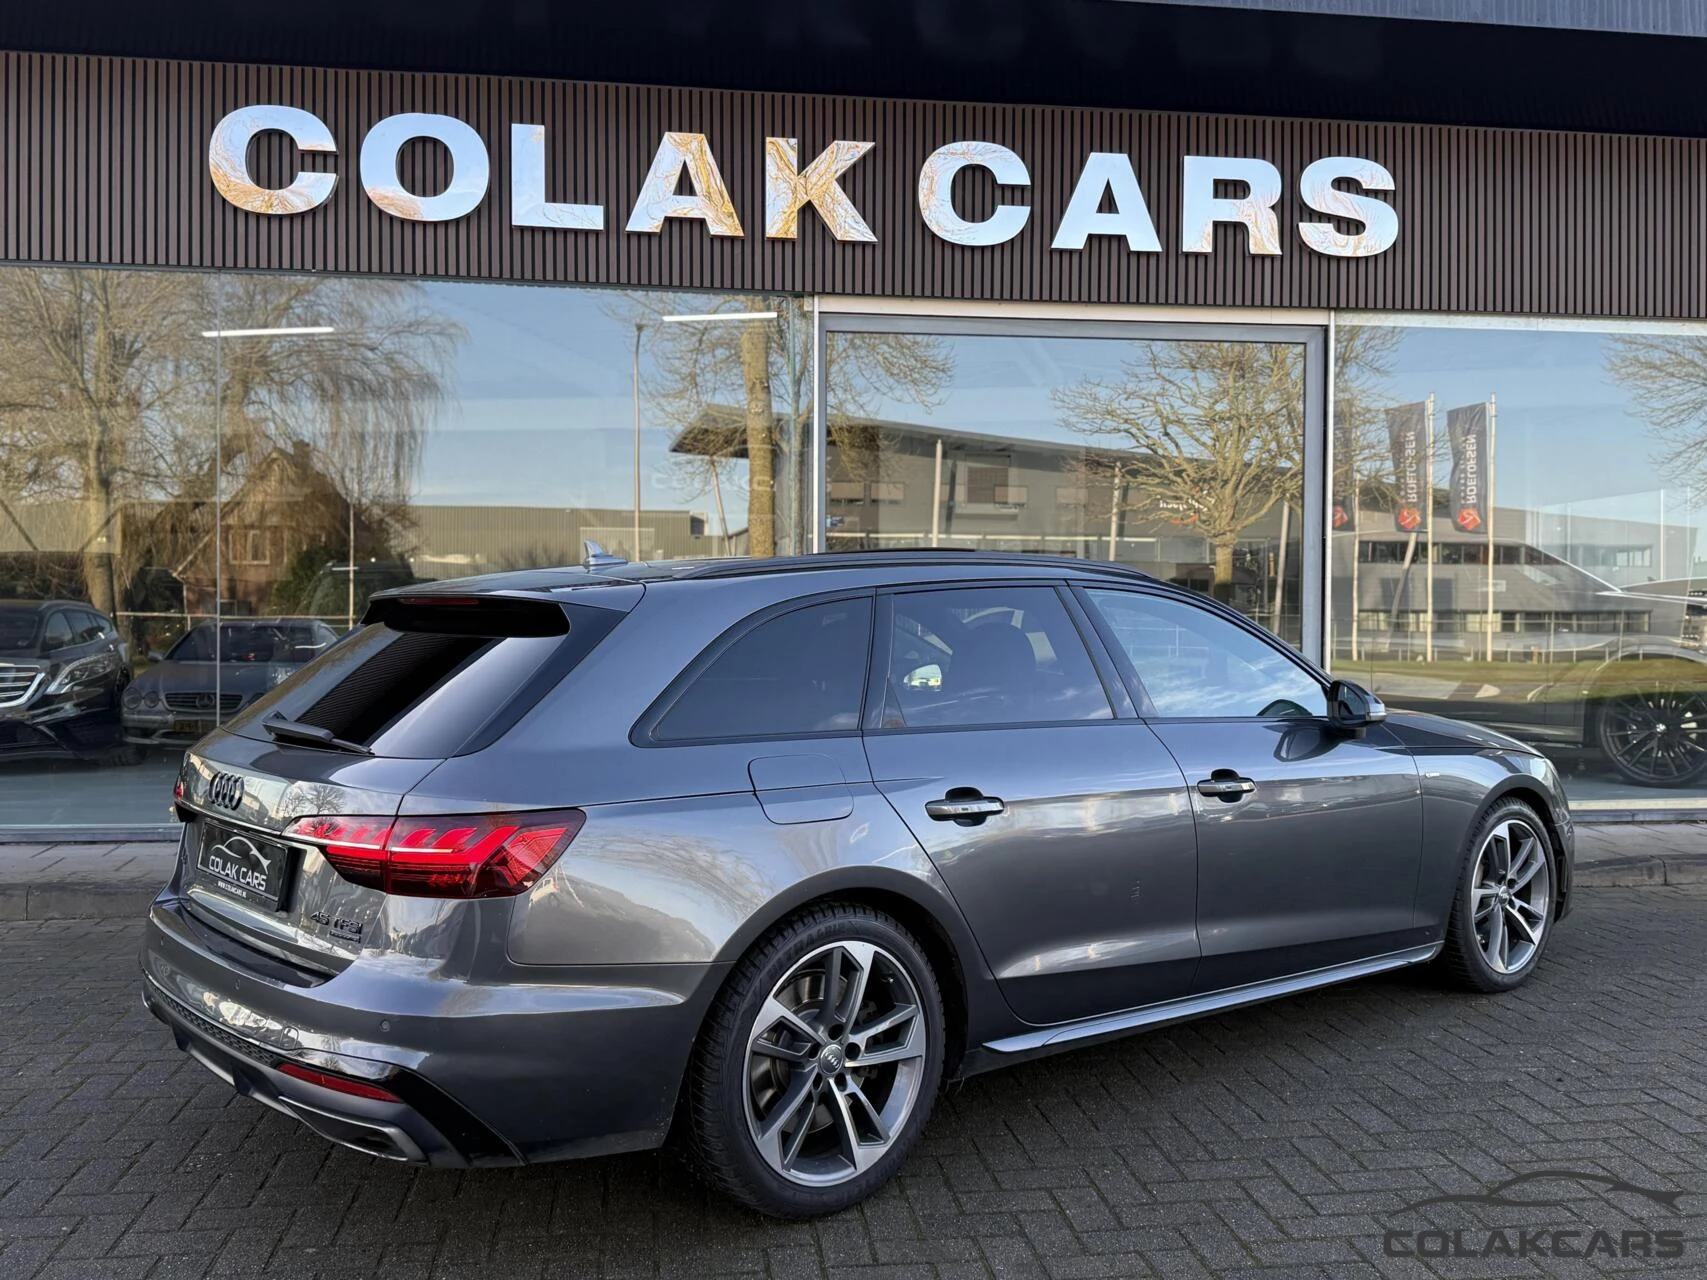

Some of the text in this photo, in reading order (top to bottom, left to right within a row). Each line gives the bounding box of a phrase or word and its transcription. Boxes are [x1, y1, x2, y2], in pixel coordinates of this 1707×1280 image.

[208, 104, 1400, 259] COLAK CARS
[208, 855, 267, 891] COLAK CARS
[310, 911, 364, 934] 45 TFSI
